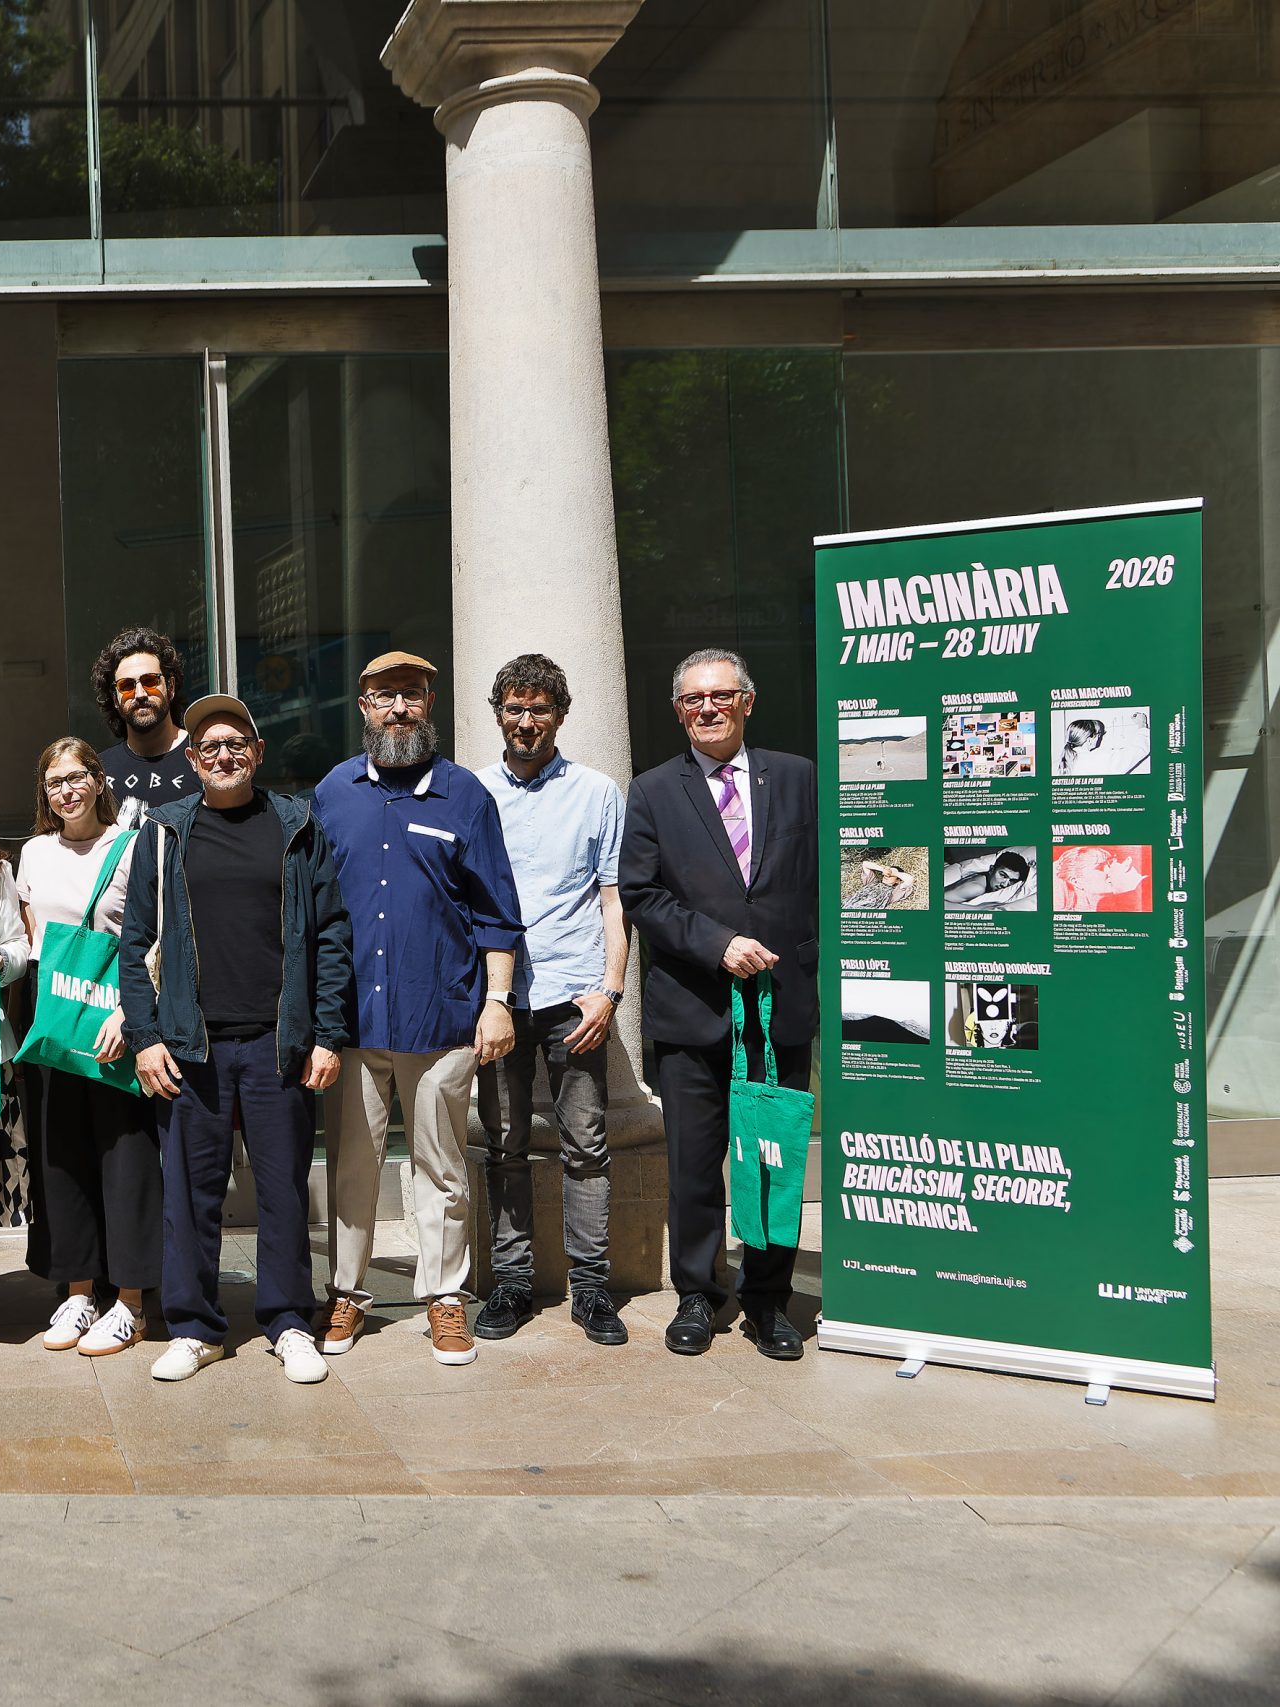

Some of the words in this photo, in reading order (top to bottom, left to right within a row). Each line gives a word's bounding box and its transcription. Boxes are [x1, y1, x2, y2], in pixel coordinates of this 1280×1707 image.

[1106, 555, 1175, 590] 2026
[836, 563, 1069, 629] IMAGINÀRIA
[840, 636, 855, 664] 7
[856, 631, 914, 663] MAIG
[942, 628, 975, 658] 28
[977, 623, 1040, 656] JUNY
[942, 694, 972, 705] CARLOS
[973, 690, 1018, 704] CHAVARRÍA
[1051, 689, 1078, 700] CLARA
[1078, 686, 1131, 699] MARCONATO
[838, 700, 858, 710] PACO
[859, 698, 878, 710] LLOP
[840, 827, 864, 838] CARLA
[865, 827, 884, 838] OSET
[944, 826, 971, 837] SAKIKO
[973, 826, 1008, 836] NOMURA
[1052, 824, 1085, 835] MARINA
[1085, 824, 1110, 835] BOBO
[840, 959, 864, 970] PABLO
[865, 958, 890, 971] LÓPEZ
[945, 962, 977, 974] ALBERTO
[978, 961, 1005, 974] FEIJÓO
[1005, 962, 1052, 975] RODRÍGUEZ
[1173, 1011, 1186, 1050] MUSEU
[841, 1132, 936, 1164] CASTELLÓ
[938, 1139, 965, 1167] DE
[966, 1141, 994, 1169] LA
[995, 1143, 1072, 1179] PLANA,
[843, 1163, 966, 1203] BENICÀSSIM,
[971, 1174, 1071, 1212] SEGORBE,
[841, 1194, 851, 1219] I
[852, 1195, 978, 1232] VILAFRANCA.
[1179, 1209, 1188, 1236] Castelló
[843, 1259, 917, 1276] UJI_encultura
[936, 1270, 1027, 1288] www.imaginaria.uji.es
[1098, 1283, 1131, 1300] UJI
[1134, 1286, 1188, 1299] UNIVERSITAT
[1135, 1294, 1163, 1304] JAUME
